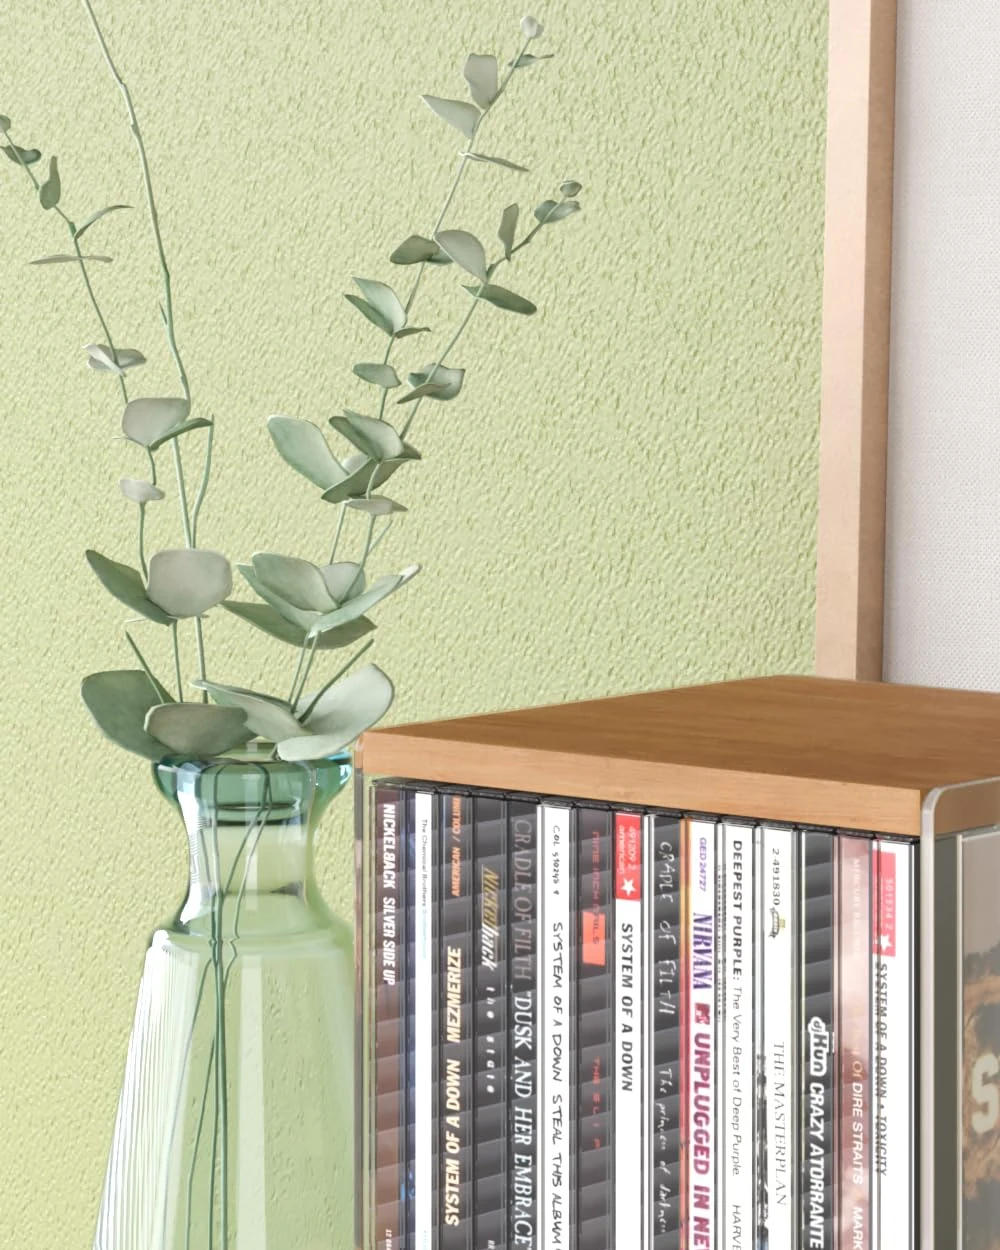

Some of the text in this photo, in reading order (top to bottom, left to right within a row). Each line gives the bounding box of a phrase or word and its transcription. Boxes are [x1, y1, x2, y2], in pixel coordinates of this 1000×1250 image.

[452, 847, 461, 897] AMERICAN
[514, 819, 532, 891] CRADLE
[731, 840, 742, 912] DEEPEST
[383, 804, 396, 986] NICKELBACK SILVER SIDE UP
[514, 896, 532, 922] OF
[514, 928, 532, 980] FILTH
[552, 922, 563, 988] SYSTEM
[658, 920, 676, 945] OF
[692, 912, 713, 990] NIRVANA
[731, 915, 742, 982] PURPLE:
[446, 946, 462, 1043] MEZMERIZE
[552, 996, 563, 1014] OF
[621, 922, 634, 1092] SYSTEM OF A DOWN
[732, 986, 743, 1011] The
[552, 1019, 563, 1027] A
[729, 1014, 742, 1042] Very
[514, 1056, 533, 1098] AND
[552, 1034, 563, 1082] DOWN
[731, 1046, 743, 1076] Best
[773, 1041, 785, 1077] THE
[875, 962, 888, 1177] SYSTEM OF DOWN TOXICITY
[446, 1060, 461, 1108] DOWN
[693, 1032, 710, 1175] UNPLUGGED
[731, 1079, 743, 1094] of
[851, 1082, 863, 1117] DIRE
[447, 1116, 460, 1127] A
[514, 1106, 533, 1145] HER
[552, 1094, 563, 1145] STEAL
[729, 1096, 742, 1131] Deep
[809, 1082, 825, 1141] CRAZY
[446, 1132, 460, 1155] OF
[773, 1081, 786, 1206] MASTERPLAN
[851, 1120, 863, 1185] STRAITS
[446, 1159, 460, 1227] SYSTEM
[552, 1152, 563, 1188] THIS
[693, 1184, 711, 1209] IN
[809, 1142, 826, 1249] ATORRANTE
[851, 1206, 863, 1250] MARK
